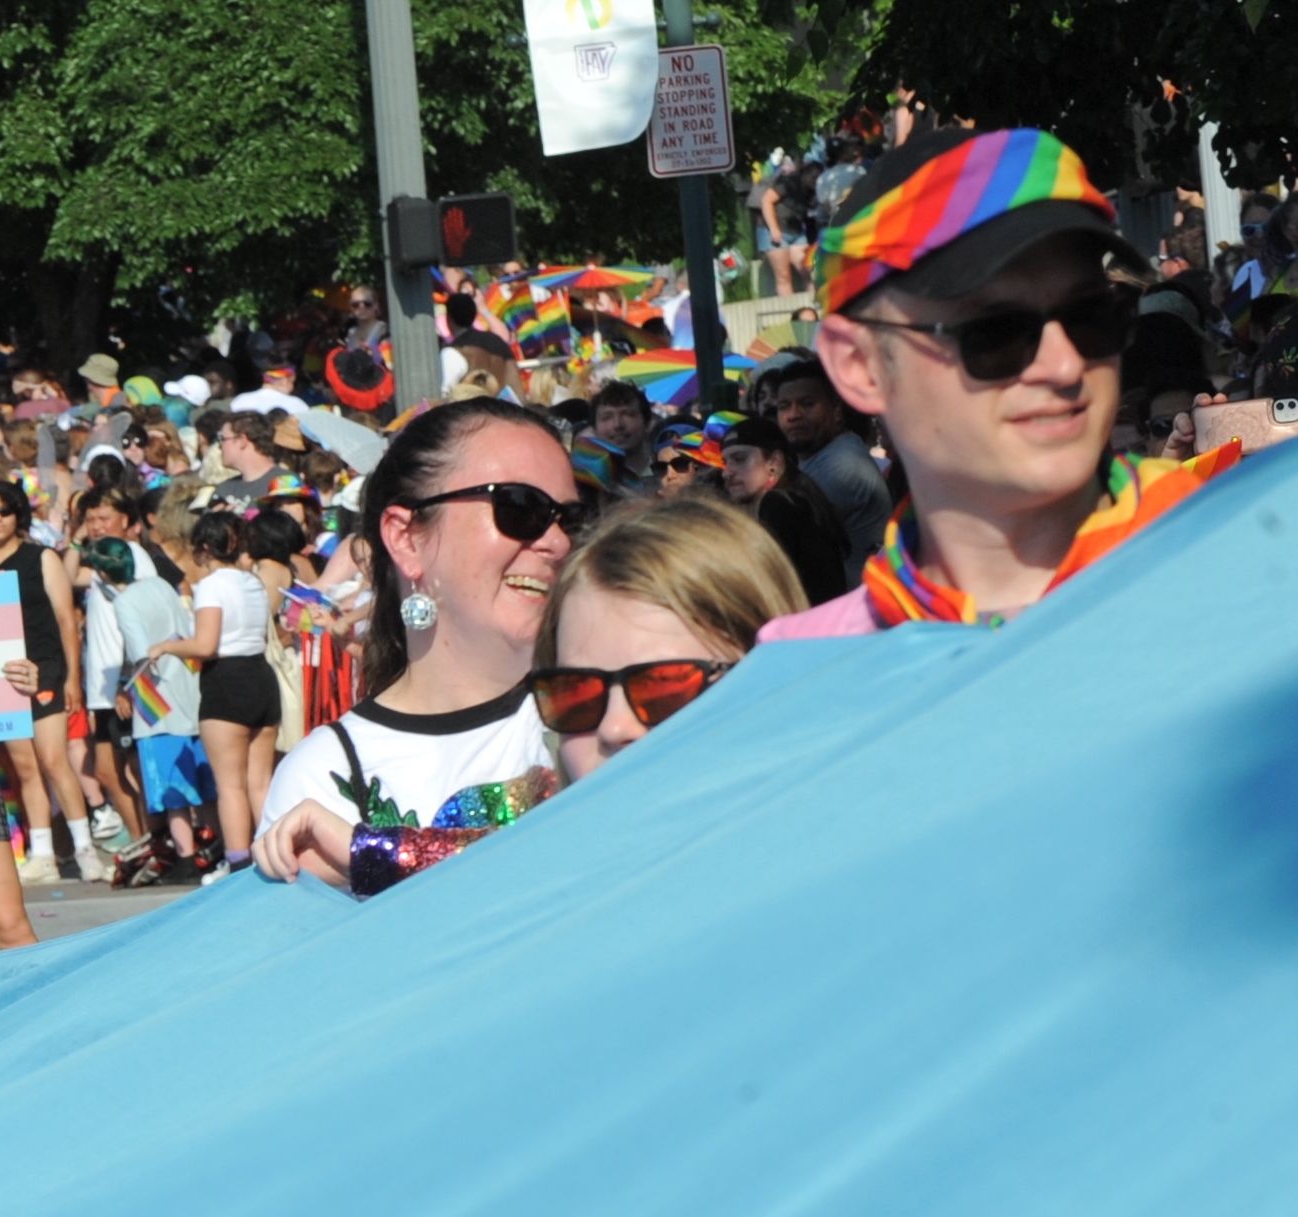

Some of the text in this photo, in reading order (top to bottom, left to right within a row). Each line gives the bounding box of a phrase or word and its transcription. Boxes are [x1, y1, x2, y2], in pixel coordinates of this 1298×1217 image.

[671, 55, 694, 73] NO
[659, 73, 710, 89] PARKING
[657, 87, 715, 104] STOPPING
[659, 103, 716, 119] STANDING
[664, 118, 714, 133] IN ROAD
[661, 132, 719, 149] ANY TIME
